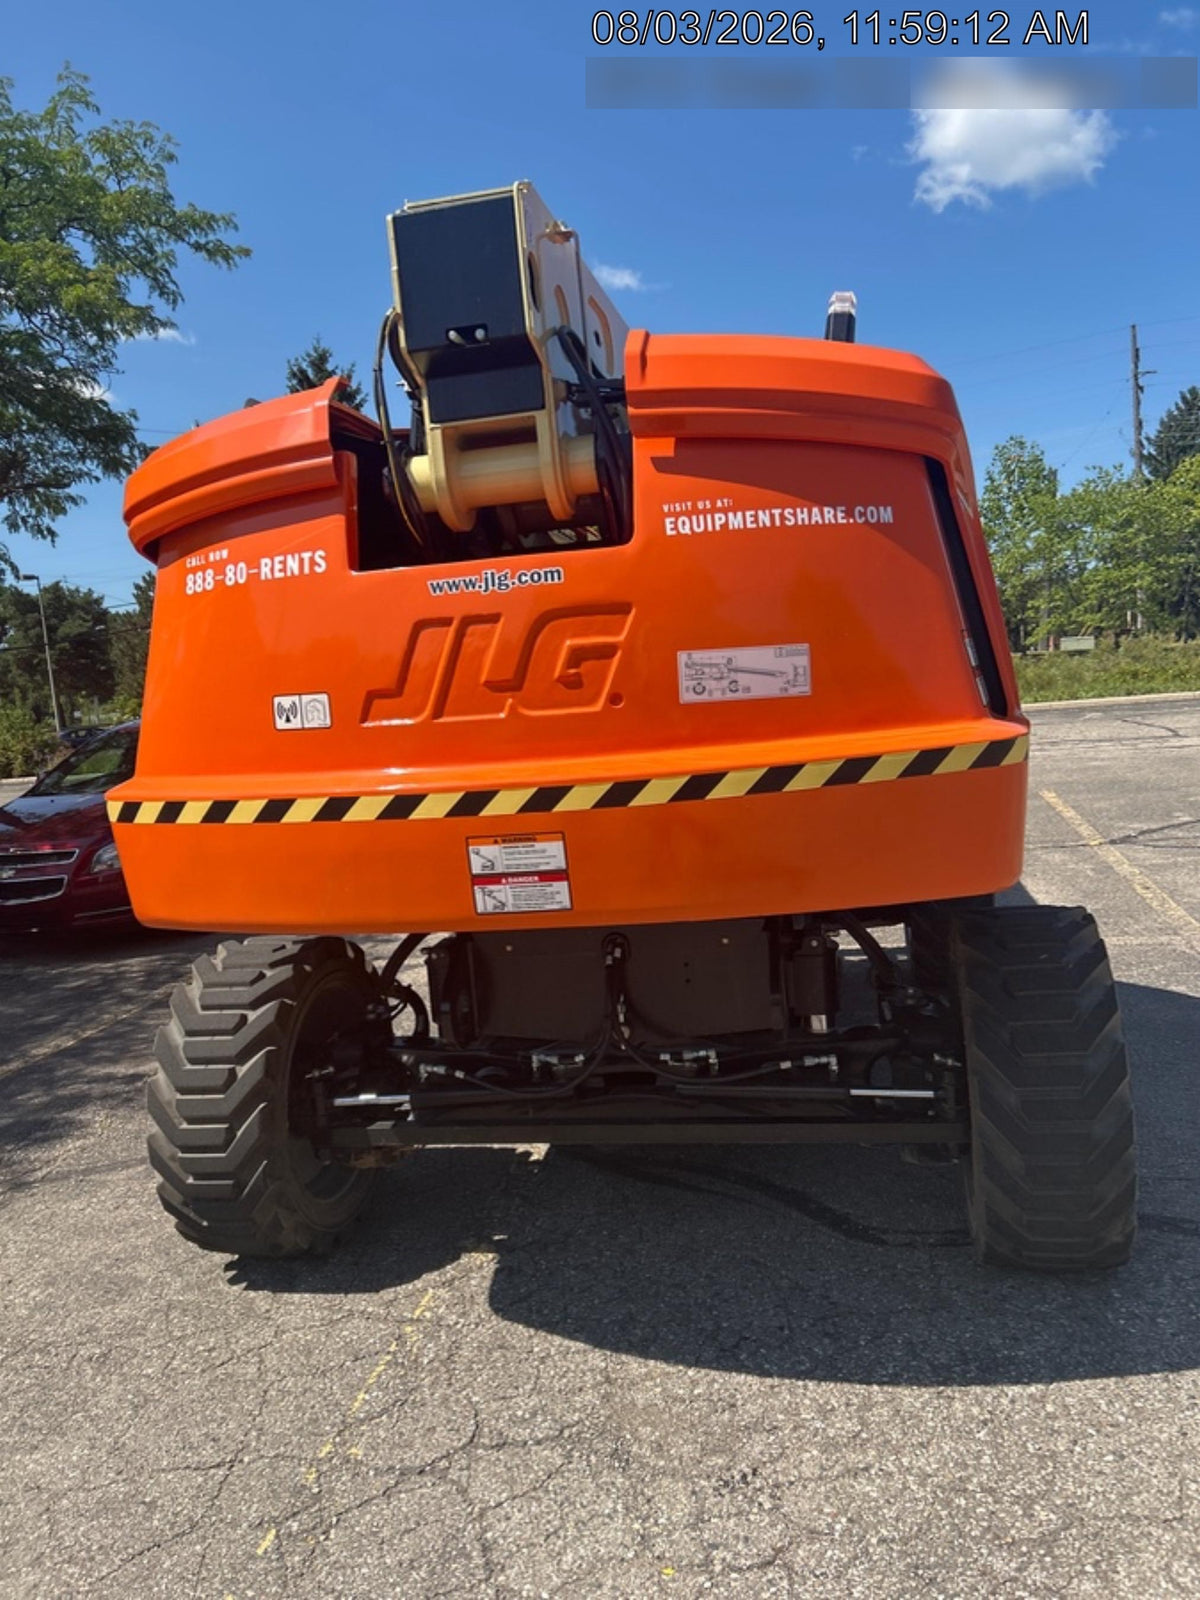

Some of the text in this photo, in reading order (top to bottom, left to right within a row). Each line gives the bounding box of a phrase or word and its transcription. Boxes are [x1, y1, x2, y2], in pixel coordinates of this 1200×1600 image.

[663, 498, 734, 513] VISIT US AT:
[664, 506, 894, 536] EQUIPMENTSHARE.COM
[185, 550, 327, 595] 888-80-RENTS
[186, 549, 229, 568] CALL NOW
[428, 565, 564, 595] www.jlg.com
